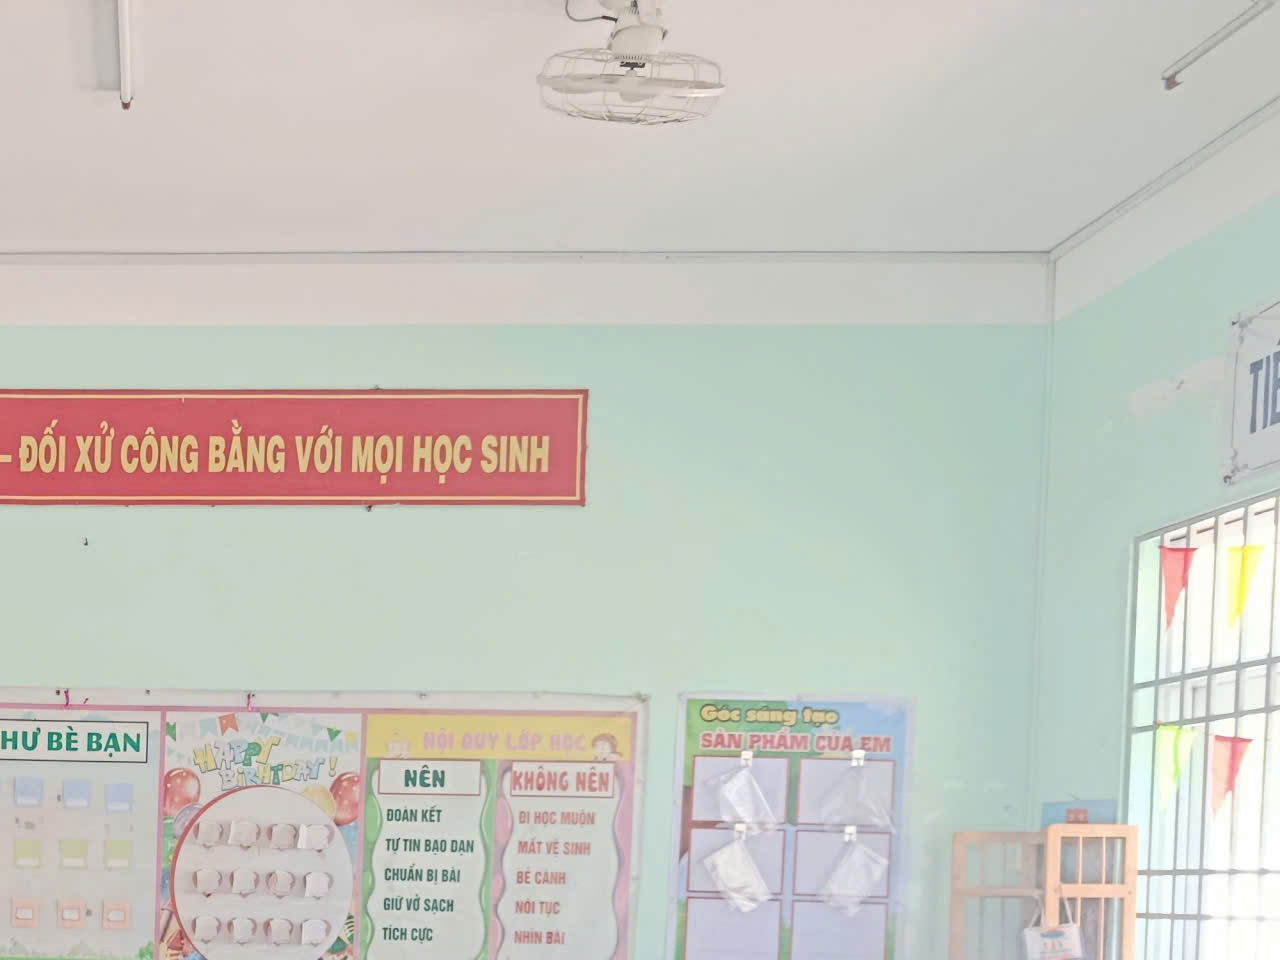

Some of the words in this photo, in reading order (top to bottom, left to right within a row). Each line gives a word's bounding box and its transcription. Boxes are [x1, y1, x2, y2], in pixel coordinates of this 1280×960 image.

[19, 420, 66, 472] ĐỐI
[74, 421, 115, 472] XỬ
[120, 427, 199, 472] CÔNG
[208, 420, 285, 472] BẰNG
[295, 425, 342, 472] VỚI
[351, 436, 403, 483] MỌI
[413, 436, 473, 483] HỌC
[480, 436, 550, 473] SINH
[701, 704, 741, 722] Góc
[47, 725, 78, 751] BÈ
[86, 732, 141, 758] BẠN
[701, 729, 742, 749] SẢN
[748, 727, 809, 750] PHẨM
[815, 731, 853, 751] CỦA
[860, 736, 892, 753] EM
[193, 737, 280, 773] HAPPY
[404, 765, 446, 788] NÊN
[512, 766, 569, 792] KHÔNG
[576, 766, 610, 792] NÊN
[386, 806, 418, 822] ĐOÀN
[421, 805, 443, 822] KẾT
[534, 811, 557, 828] HỌC
[385, 837, 400, 855] TỰ
[402, 839, 420, 852] TIN
[424, 839, 447, 855] BẠO
[450, 840, 475, 856] DẠN
[562, 842, 592, 856] SINH
[426, 869, 438, 885] BỊ
[441, 866, 461, 883] BÀI
[423, 899, 454, 915] SẠCH
[382, 924, 407, 941] TÍCH
[410, 926, 433, 944] CỰC
